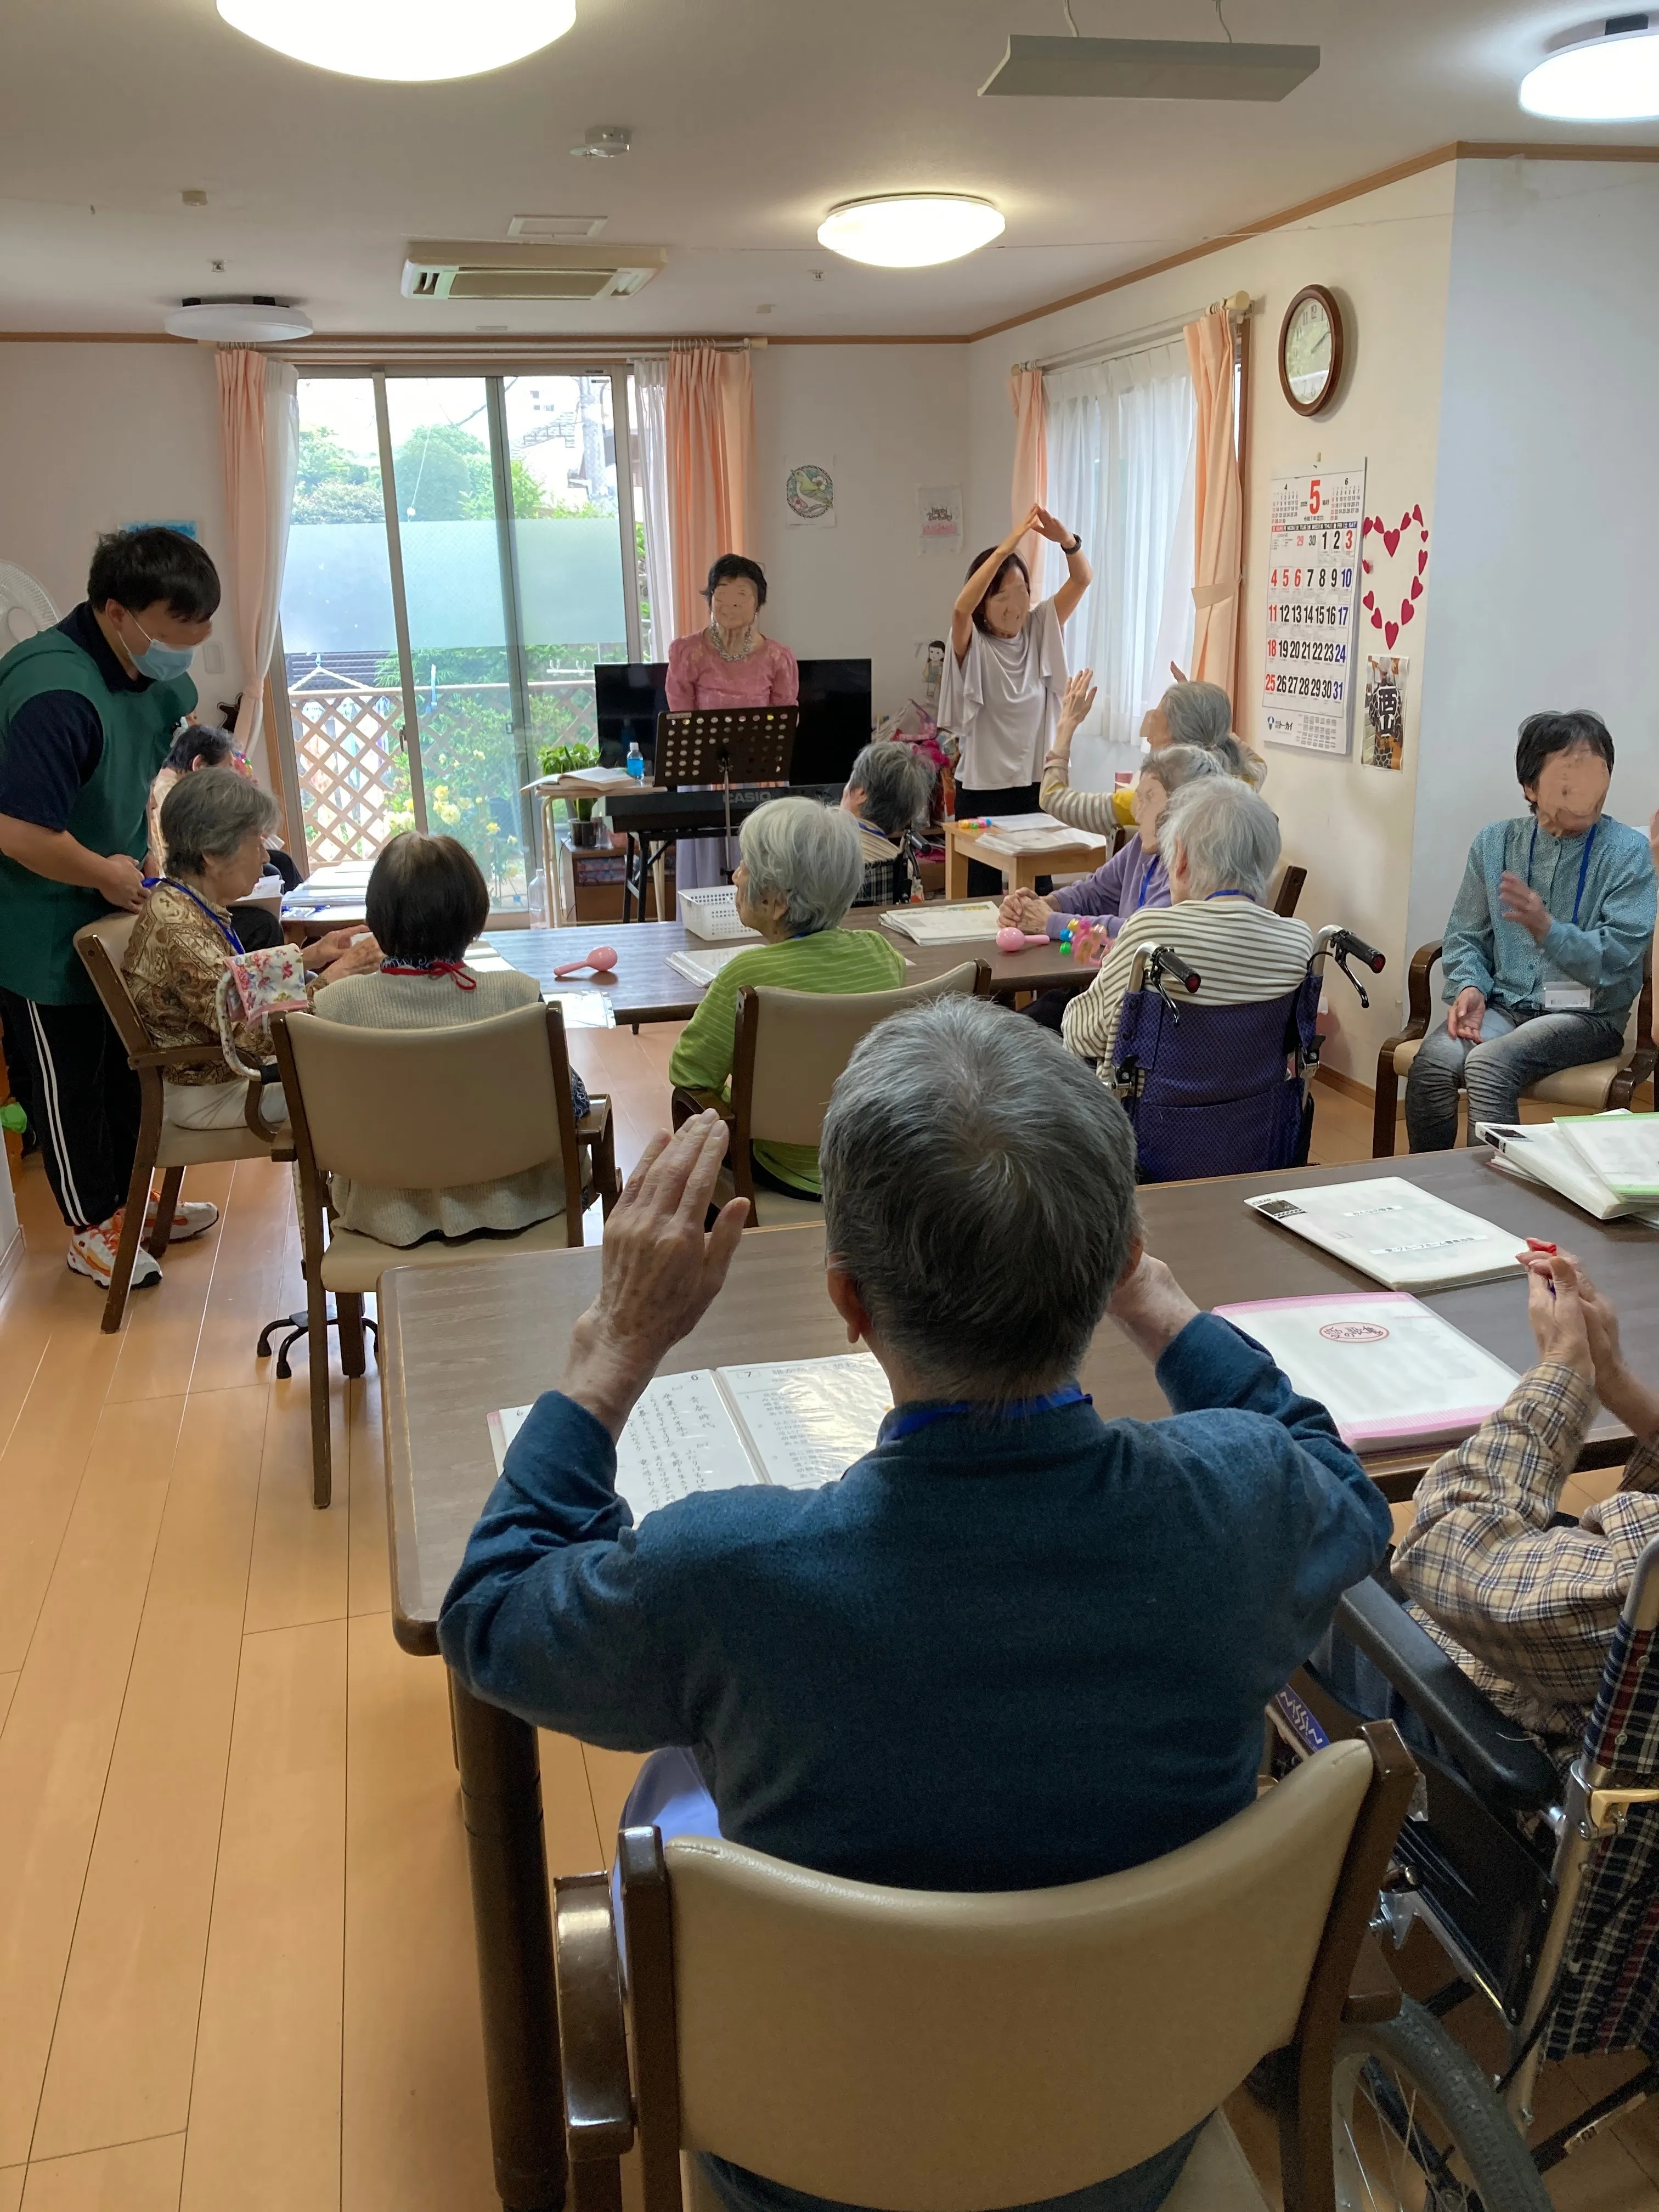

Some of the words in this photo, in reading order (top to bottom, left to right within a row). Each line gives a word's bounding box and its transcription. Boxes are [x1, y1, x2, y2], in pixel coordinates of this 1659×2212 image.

[1302, 312, 1308, 326] 11
[1311, 304, 1317, 319] 12
[1310, 479, 1321, 515] 5
[1297, 535, 1304, 546] 29
[1308, 535, 1316, 546] 30
[1322, 531, 1327, 549] 1
[1333, 531, 1340, 549] 2
[1345, 530, 1353, 549] 3
[1271, 569, 1277, 586] 4
[1283, 569, 1289, 586] 5
[1294, 568, 1301, 587] 6
[1307, 569, 1313, 586] 7
[1319, 568, 1325, 587] 8
[1331, 568, 1338, 587] 9
[1341, 568, 1352, 588] 10
[1269, 605, 1277, 622] 11
[1279, 605, 1289, 622] 12
[1292, 605, 1301, 623] 13
[1304, 605, 1313, 623] 14
[1315, 606, 1324, 624] 15
[1327, 606, 1335, 624] 16
[1338, 607, 1348, 625] 17
[1268, 639, 1277, 657] 18
[1279, 640, 1288, 657] 19
[1290, 641, 1300, 658] 20
[1301, 641, 1311, 659] 21
[1312, 642, 1322, 661] 22
[1324, 644, 1334, 662] 23
[1335, 645, 1346, 663] 24
[1265, 674, 1275, 691] 25
[1277, 675, 1286, 693] 26
[1288, 676, 1298, 693] 27
[1299, 678, 1309, 695] 28
[1311, 679, 1320, 697] 29
[1322, 680, 1331, 699] 30
[1333, 681, 1343, 699] 31
[723, 791, 771, 803] CASIO
[1279, 1691, 1323, 1745] NISSIN
